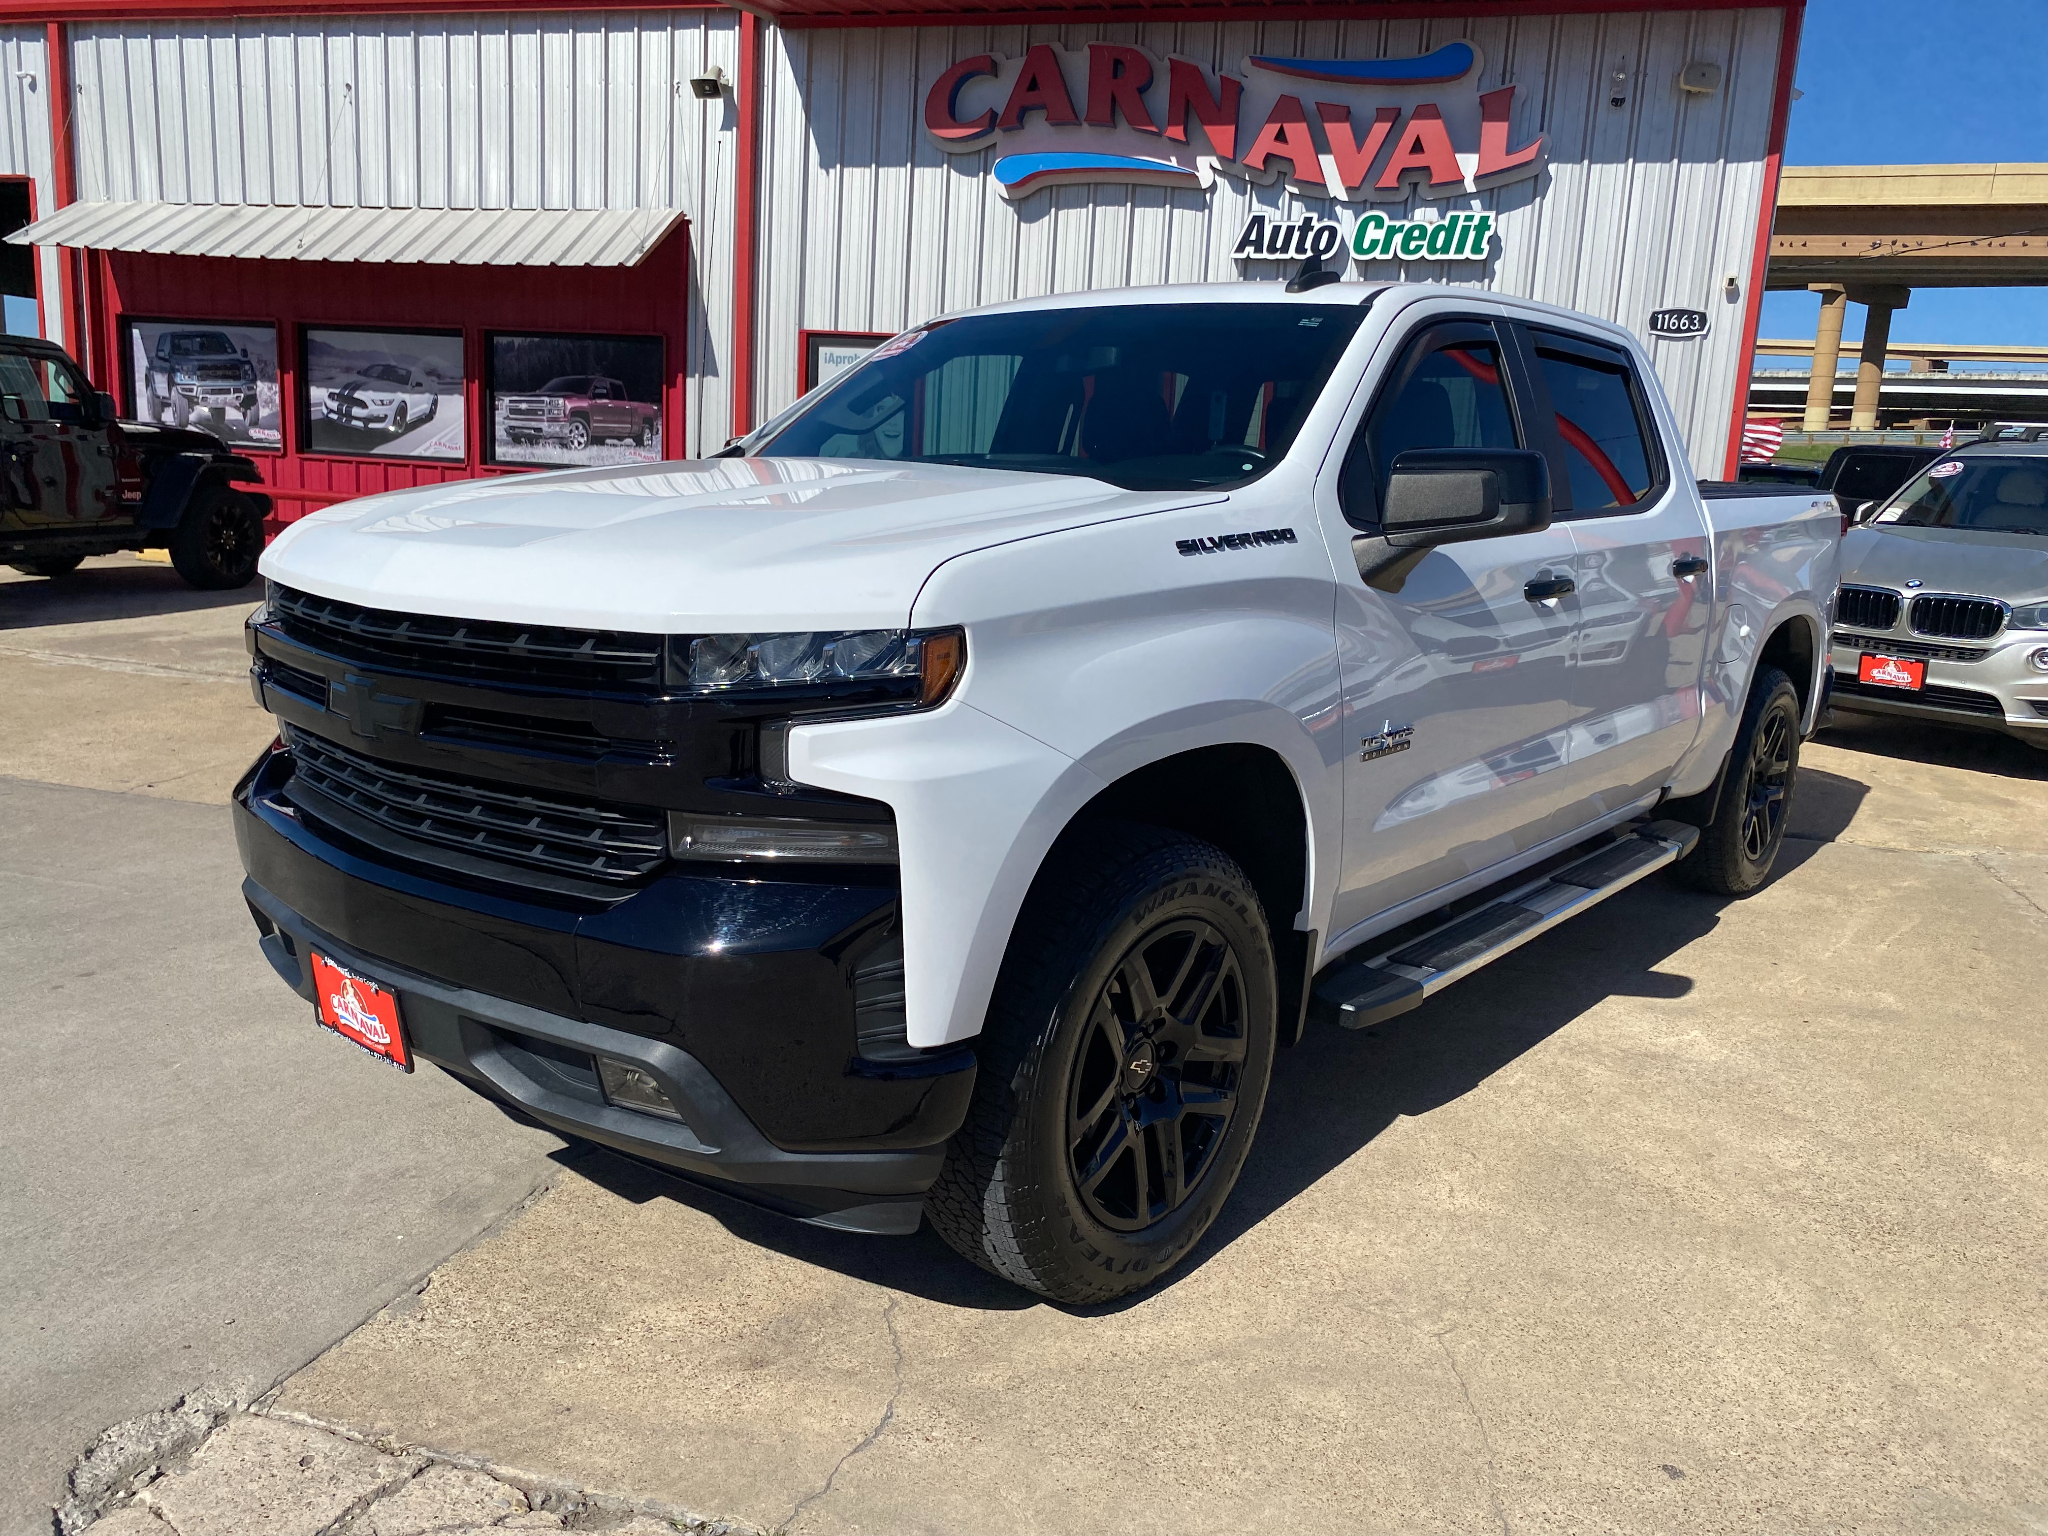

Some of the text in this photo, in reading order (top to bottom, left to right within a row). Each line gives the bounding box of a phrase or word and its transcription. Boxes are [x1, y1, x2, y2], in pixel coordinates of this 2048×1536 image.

[925, 44, 1543, 190] CARNAVAL
[1234, 214, 1492, 256] Auto Credit
[1657, 313, 1699, 330] 11663
[121, 490, 142, 501] Jeep
[1175, 528, 1297, 556] SILVERADO
[1871, 669, 1910, 681] CARNAVAL
[330, 995, 388, 1041] CARNAVAL
